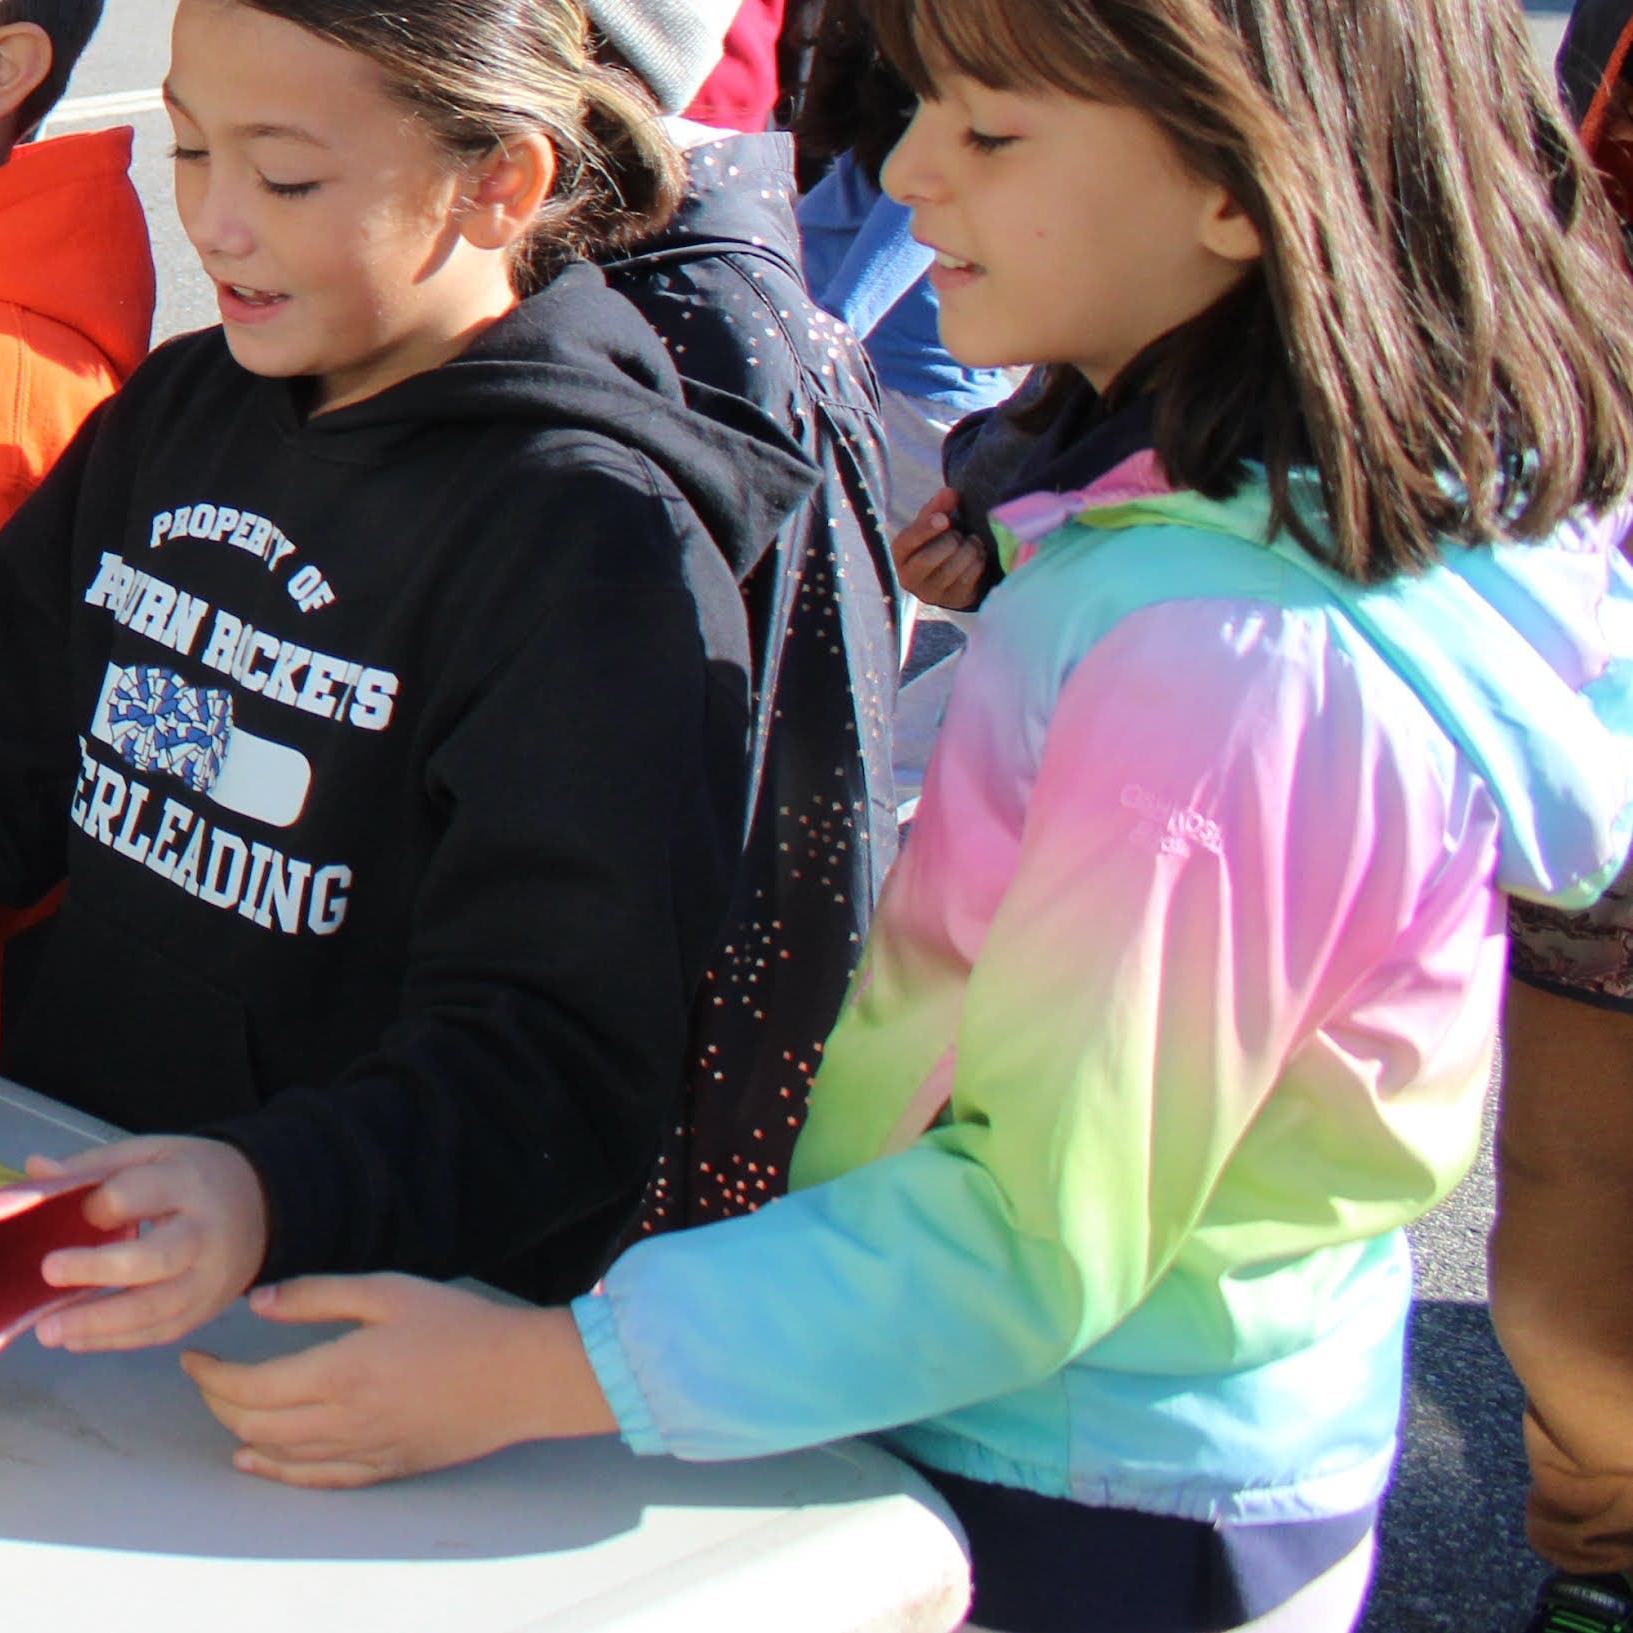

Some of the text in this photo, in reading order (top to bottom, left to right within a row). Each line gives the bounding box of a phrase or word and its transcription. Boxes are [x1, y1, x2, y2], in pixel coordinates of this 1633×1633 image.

[150, 503, 336, 613] PROPERTY OF
[71, 735, 352, 935] ERLEADING
